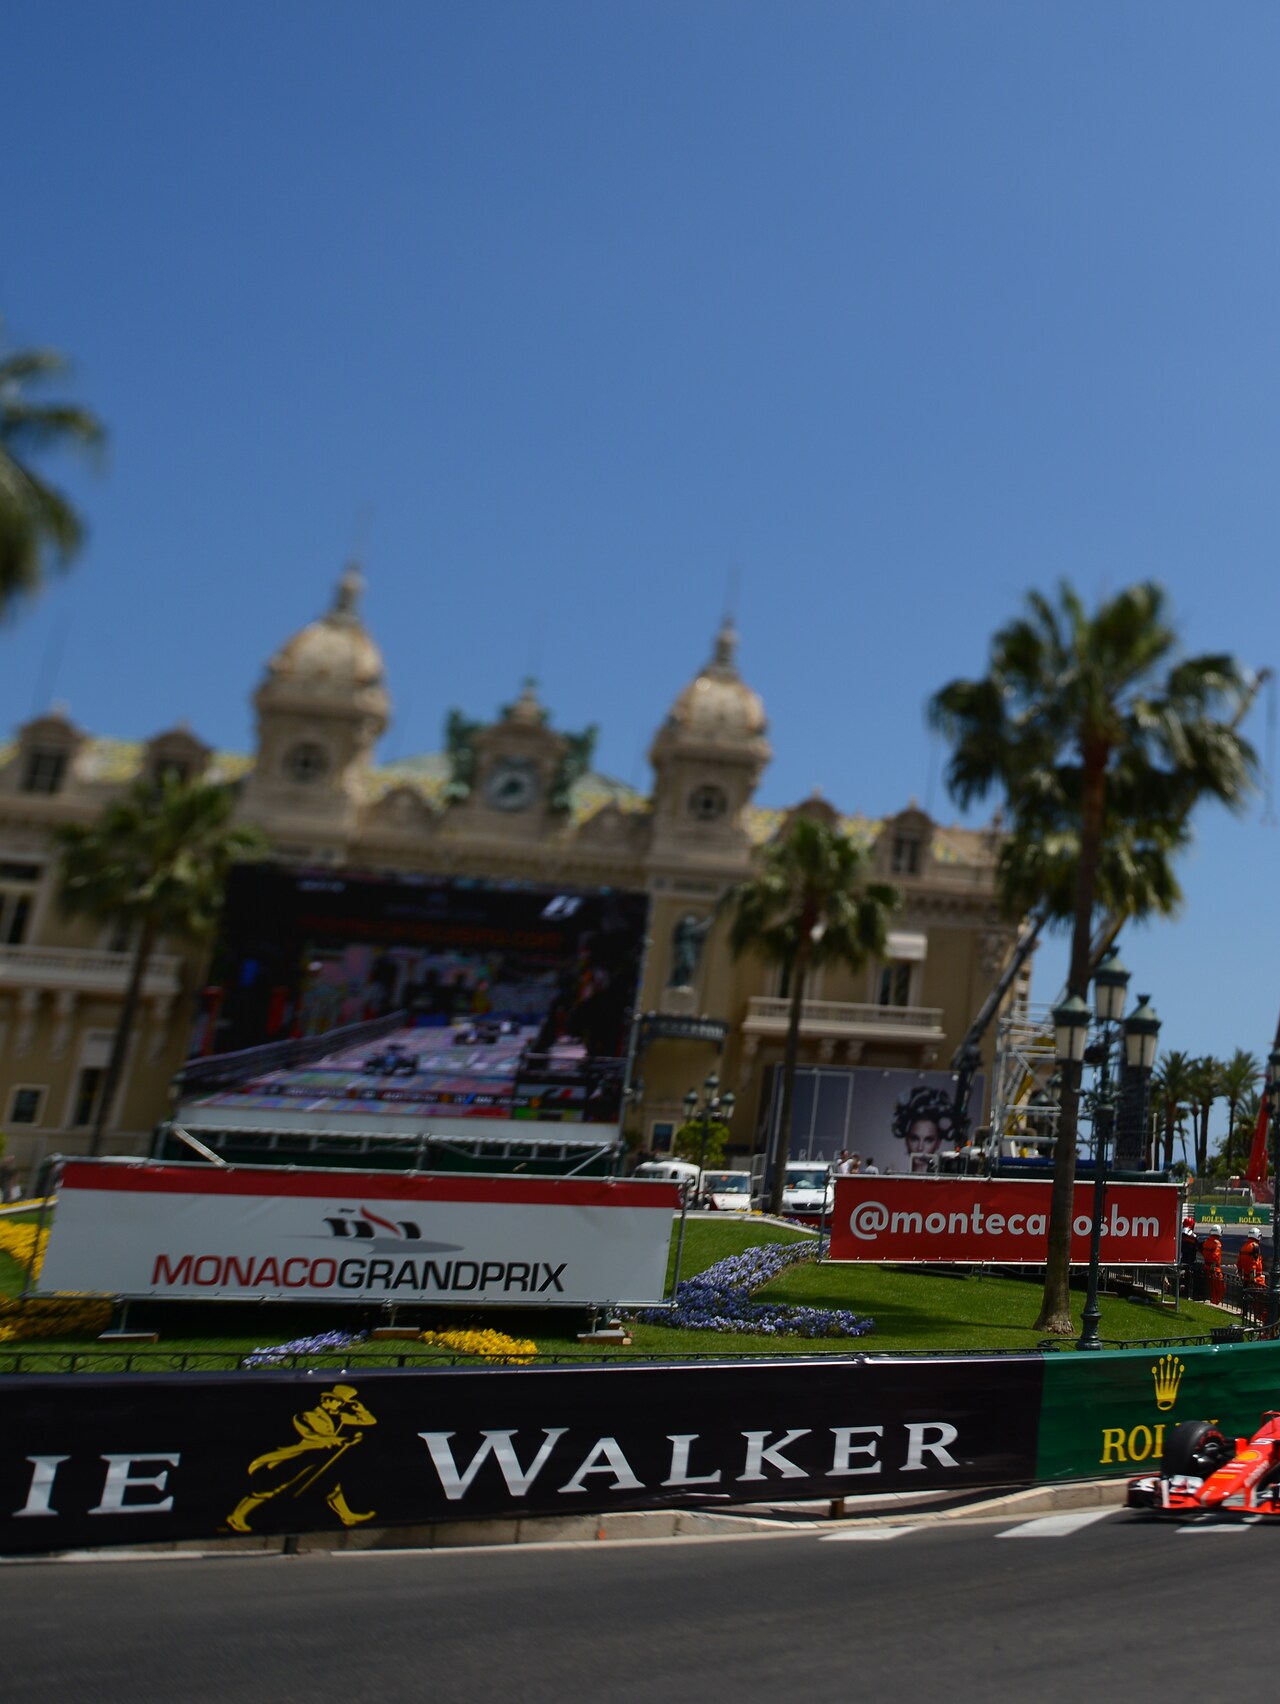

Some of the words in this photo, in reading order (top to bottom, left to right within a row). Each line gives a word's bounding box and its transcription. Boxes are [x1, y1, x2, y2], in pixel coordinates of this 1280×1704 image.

[849, 1202, 1160, 1240] @montecaosbm
[1201, 1215, 1224, 1224] ROLEX
[1238, 1216, 1262, 1224] ROLEX
[418, 1422, 960, 1500] WALKER
